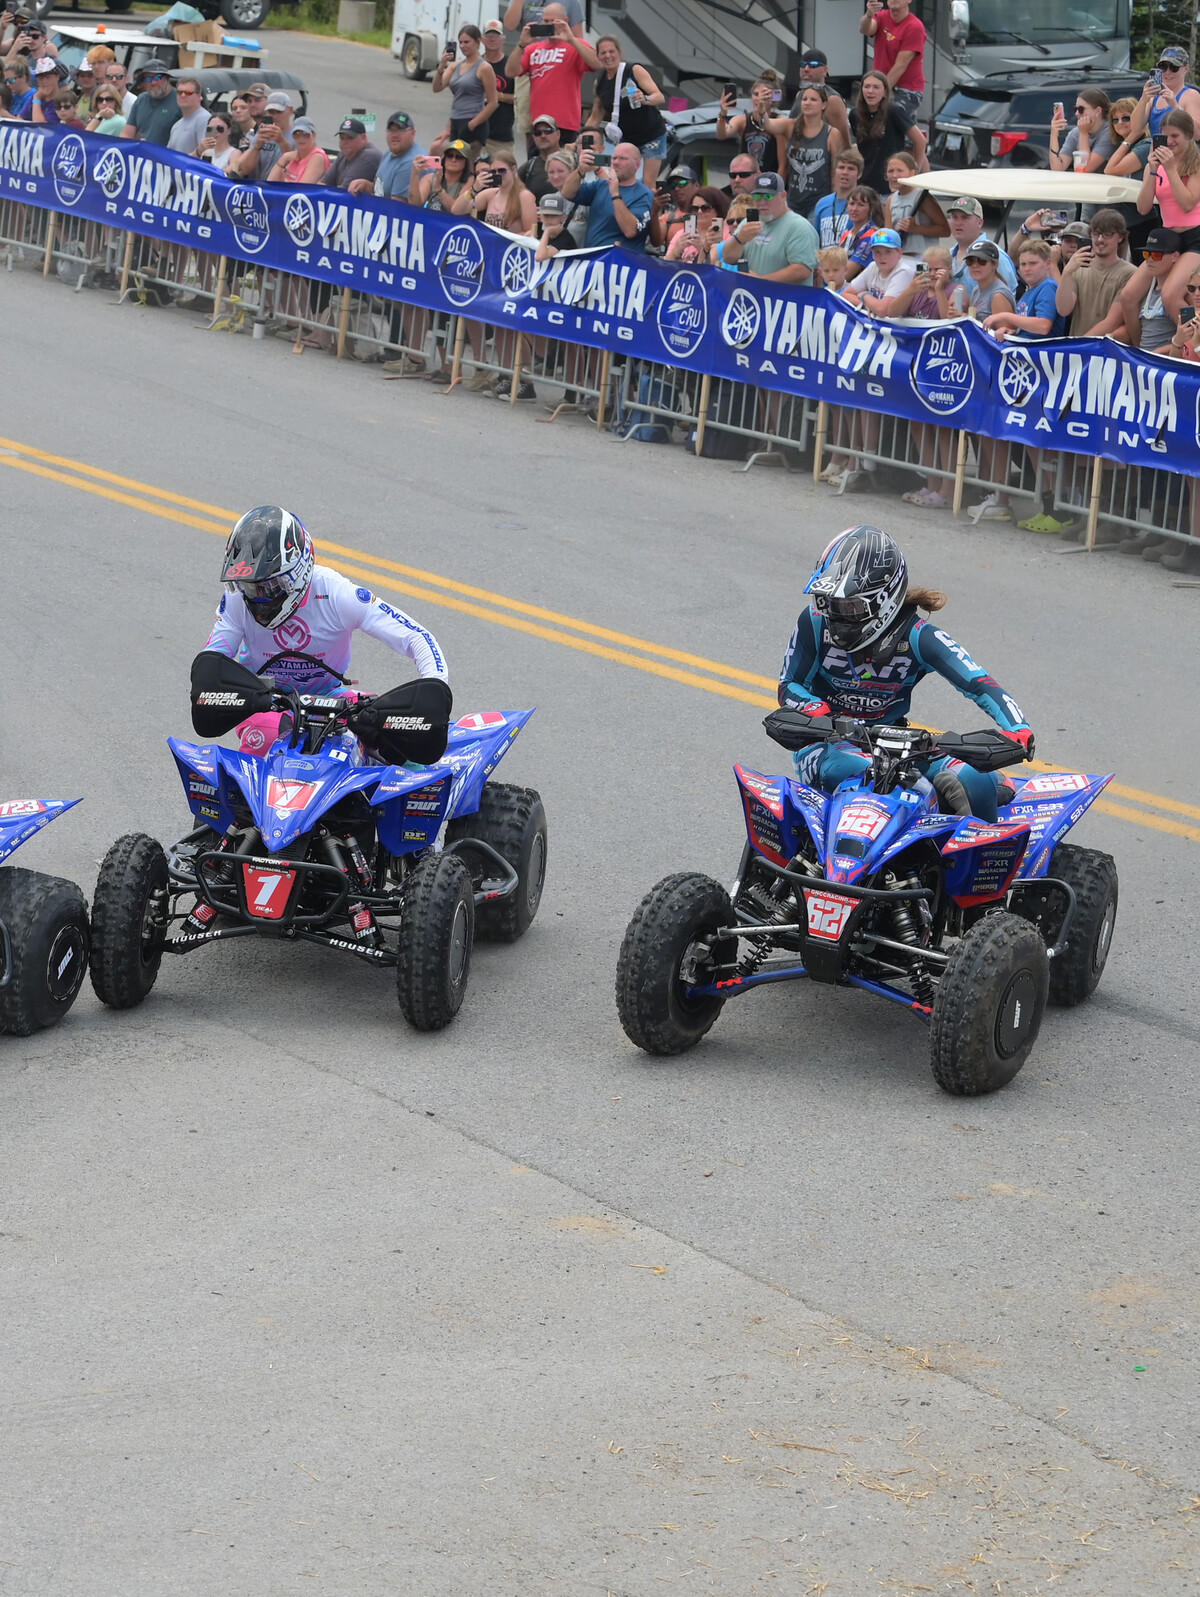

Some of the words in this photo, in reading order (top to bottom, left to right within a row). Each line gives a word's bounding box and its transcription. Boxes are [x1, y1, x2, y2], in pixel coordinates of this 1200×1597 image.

[530, 48, 567, 66] RIDE
[128, 154, 222, 223] YAMAHA
[105, 200, 212, 239] RACING
[317, 200, 426, 273] YAMAHA
[296, 249, 418, 291] RACING
[528, 259, 647, 323] YAMAHA
[502, 300, 634, 341] RACING
[762, 296, 898, 379] YAMAHA
[735, 353, 885, 397] RACING
[1038, 350, 1178, 433] YAMAHA
[1005, 410, 1168, 454] RACING
[199, 692, 239, 700] MOOSE
[204, 698, 246, 706] RACING
[826, 696, 863, 712] HOUSER
[385, 716, 425, 724] MOOSE
[390, 722, 432, 731] RACING
[880, 727, 912, 736] flexx
[1034, 775, 1086, 792] 621
[409, 793, 438, 801] CST
[0, 799, 40, 816] 723
[406, 801, 441, 811] DWT
[1015, 805, 1035, 814] FXR
[836, 809, 889, 841] 621
[252, 857, 281, 865] FACTORY
[254, 875, 282, 906] 1
[187, 914, 207, 931] Elka
[807, 896, 852, 935] 621
[172, 929, 222, 944] HOUSER
[356, 926, 377, 940] Elka
[328, 938, 384, 957] HOUSER
